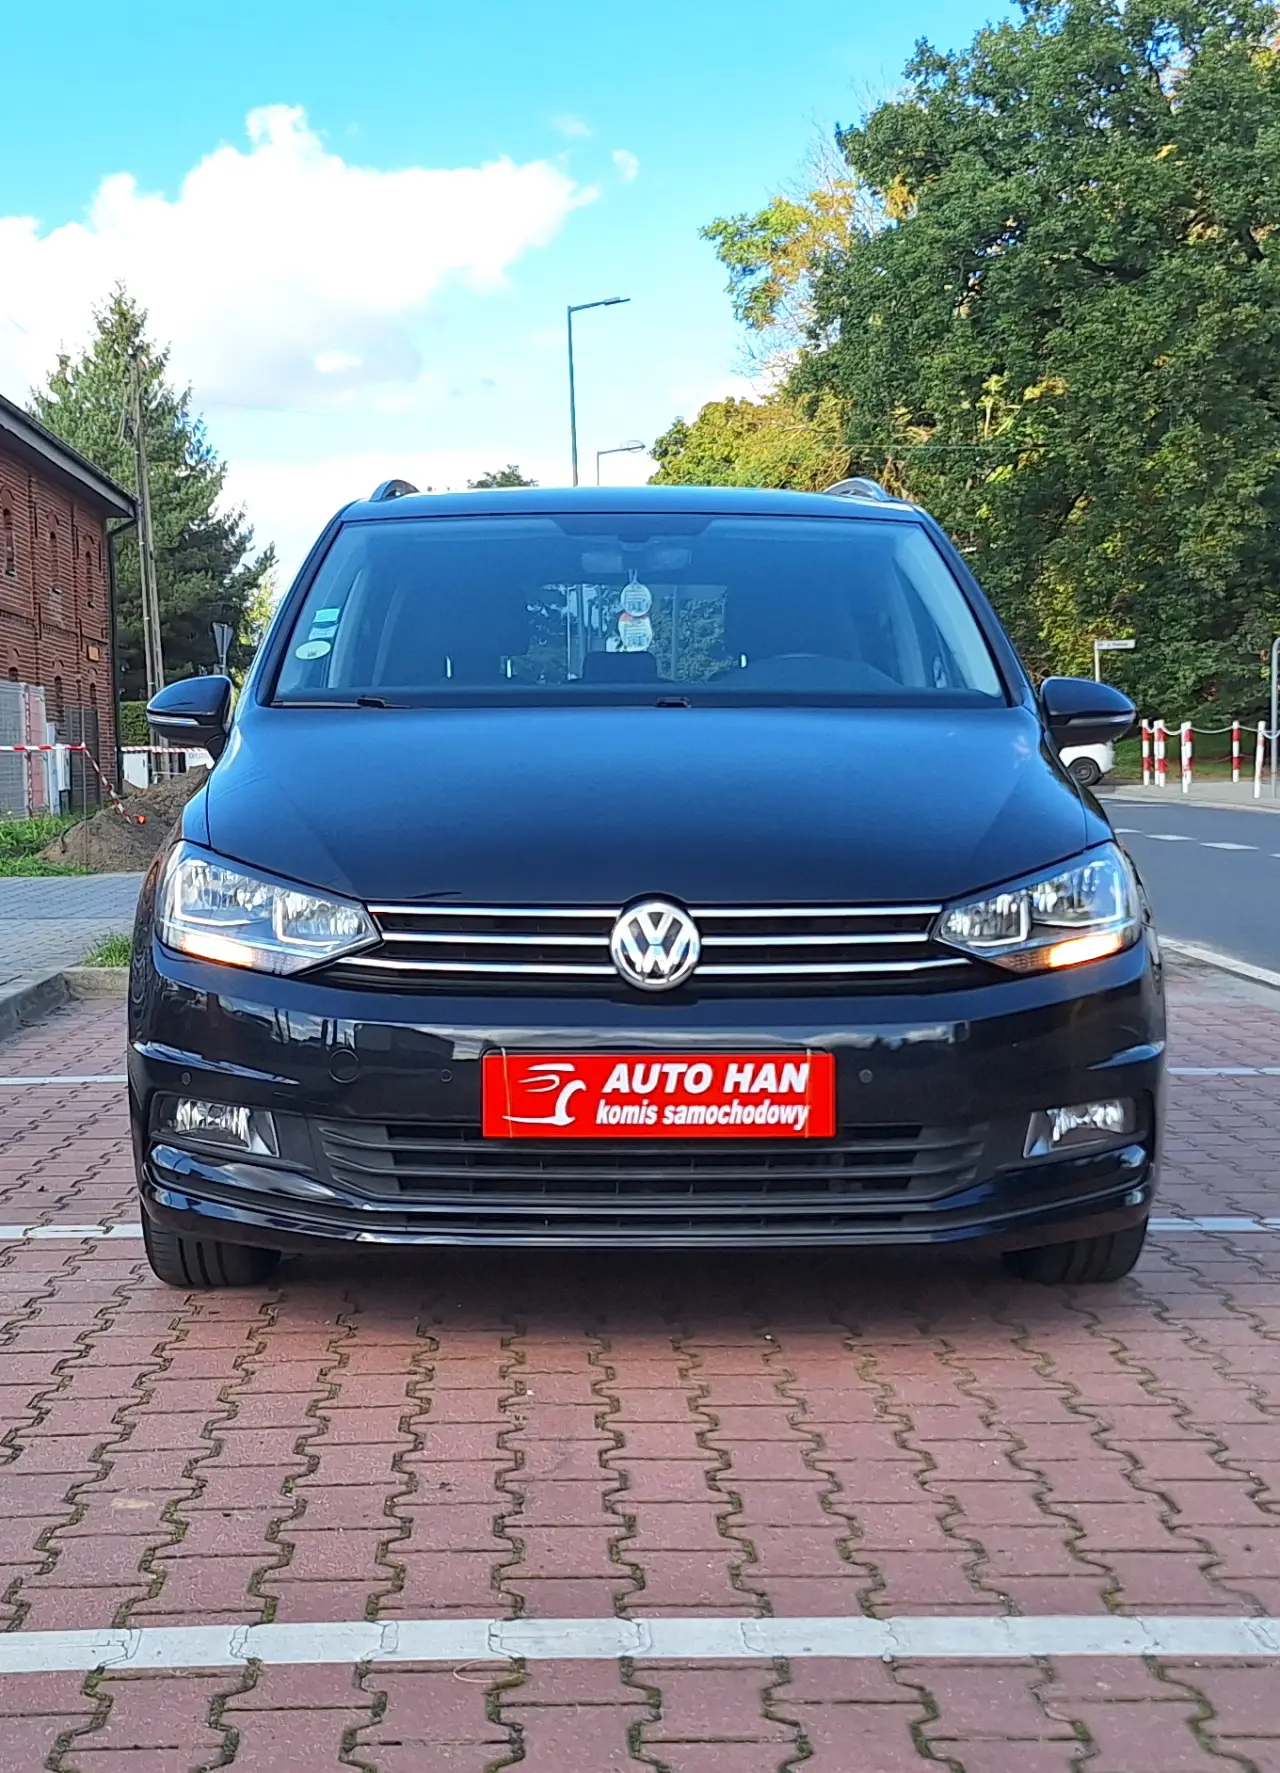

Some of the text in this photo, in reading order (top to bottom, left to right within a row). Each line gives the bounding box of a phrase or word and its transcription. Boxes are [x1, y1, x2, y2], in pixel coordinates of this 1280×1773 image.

[602, 1062, 810, 1095] AUTO HAN
[596, 1099, 810, 1131] komis samochodowy
